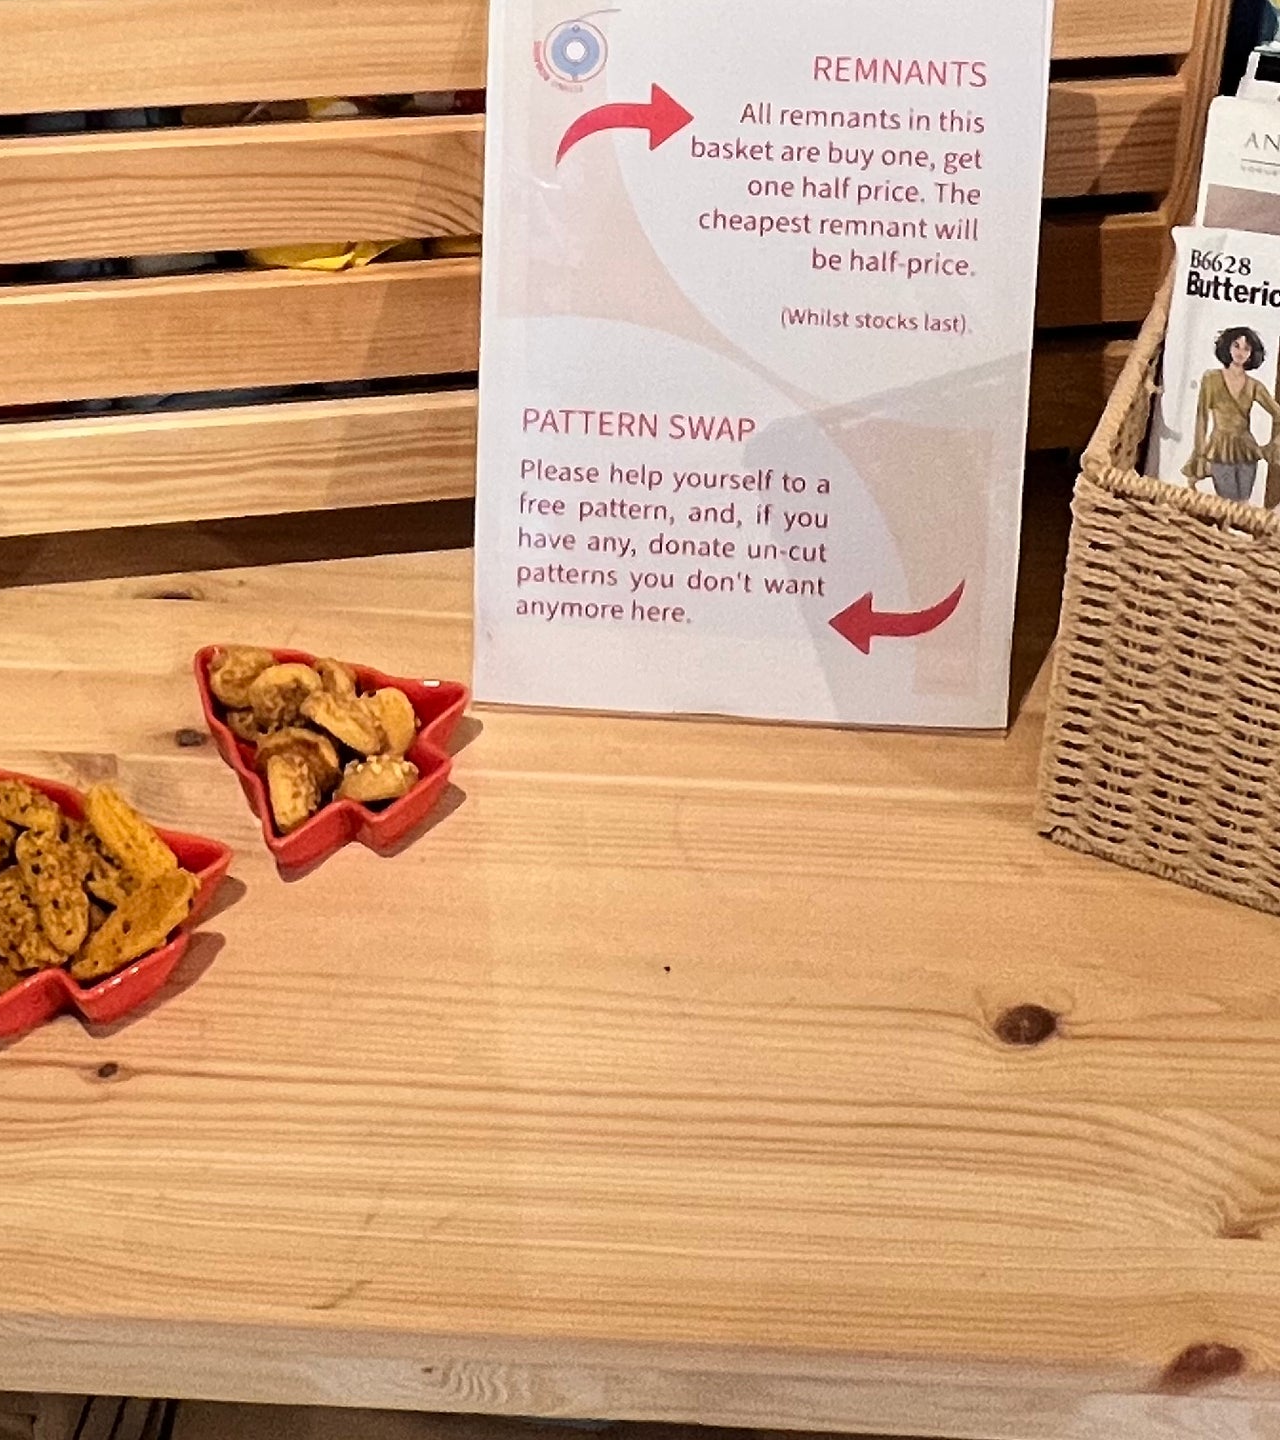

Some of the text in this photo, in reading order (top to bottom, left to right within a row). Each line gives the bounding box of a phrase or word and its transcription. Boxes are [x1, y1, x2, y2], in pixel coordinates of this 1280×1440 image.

[814, 56, 987, 87] REMNANTS
[740, 102, 984, 134] All remnants in this
[691, 136, 982, 175] basket are buy one, get
[748, 176, 980, 205] one half price. The
[699, 207, 978, 241] cheapest remnant will
[812, 246, 975, 279] be half-price.
[1190, 249, 1251, 275] B6628
[781, 307, 849, 329] (Whilst
[855, 312, 918, 331] stocks
[523, 408, 755, 442] PATTERN SWAP
[521, 459, 830, 495] Please help yourself to a
[520, 491, 828, 533] free pattern, and, if you
[519, 526, 827, 563] have any, donate un-cut
[517, 564, 825, 597] patterns you don't want
[516, 599, 691, 624] anymore here.
